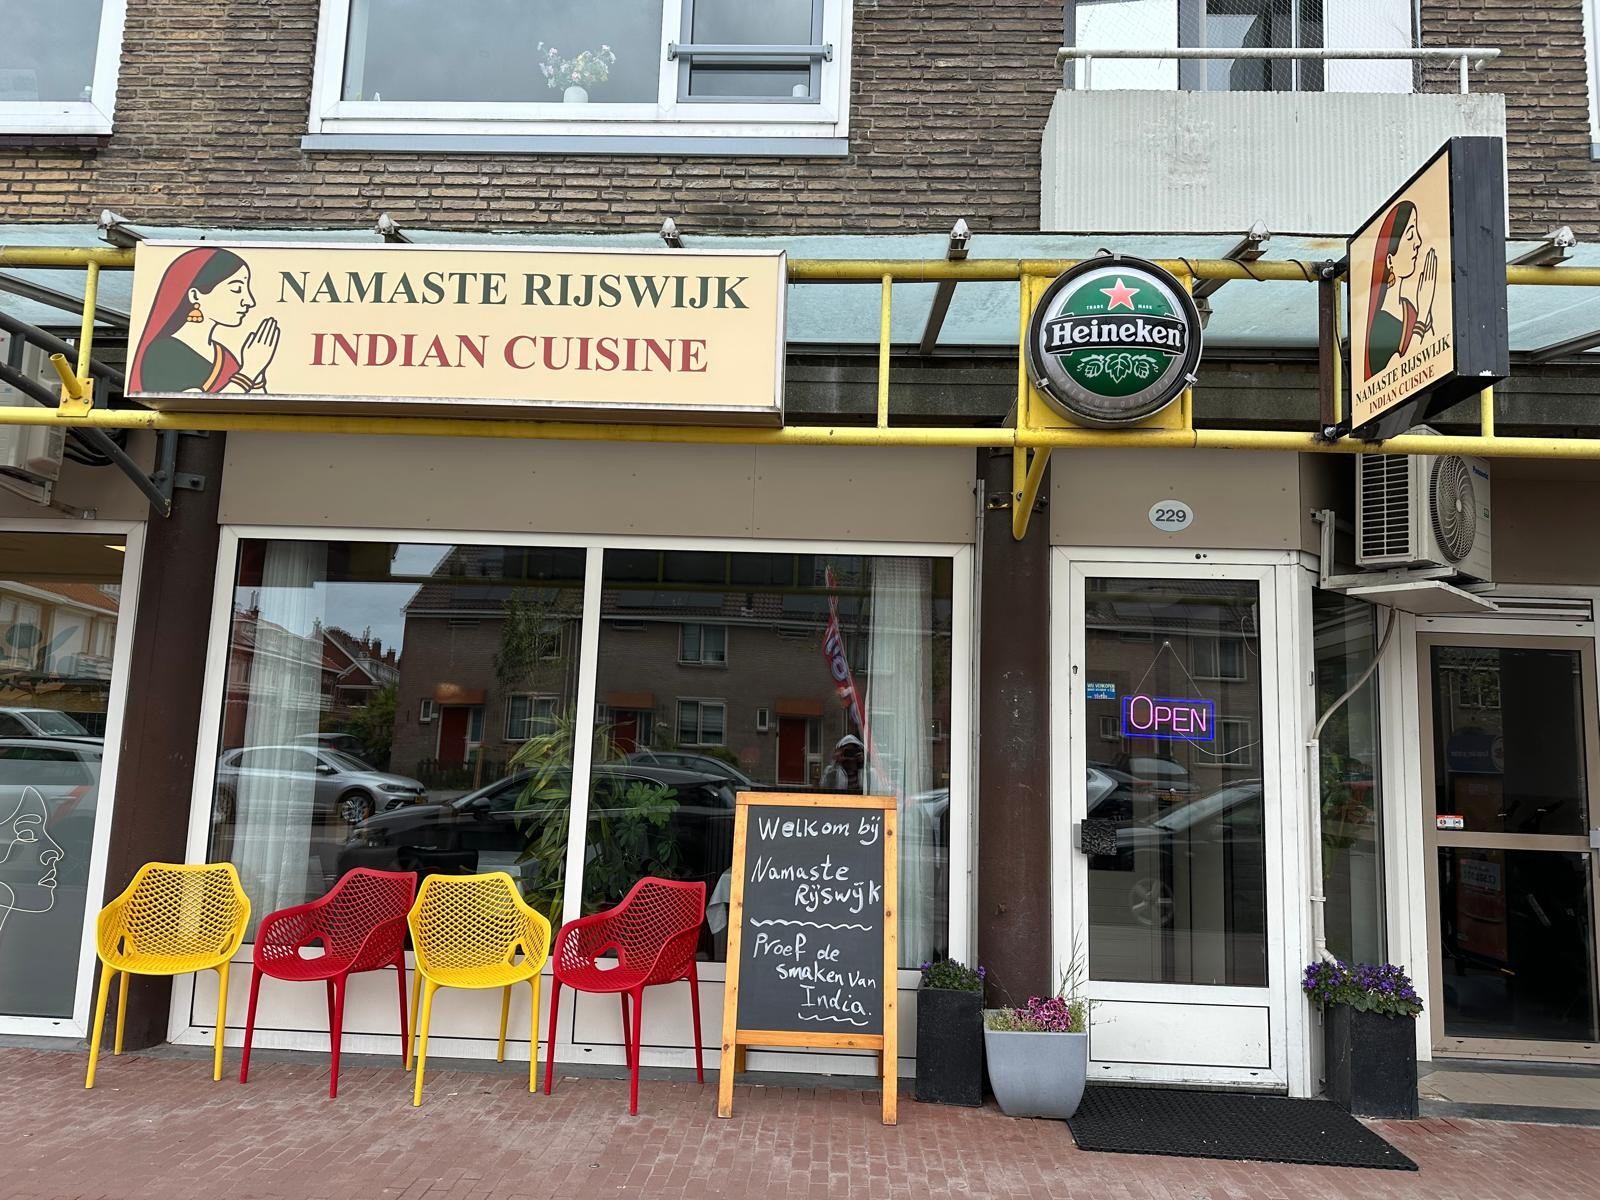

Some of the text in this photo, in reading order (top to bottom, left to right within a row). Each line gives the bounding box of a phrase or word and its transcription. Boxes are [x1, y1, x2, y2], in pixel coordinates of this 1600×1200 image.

[278, 270, 751, 310] NAMASTE RIJSWIJK
[1051, 319, 1181, 348] Heineken
[309, 331, 708, 373] INDIAN CUISINE
[1355, 333, 1451, 407] NAMASTE RIJSWIJK
[1369, 364, 1435, 414] INDIAN CUISINE
[1155, 508, 1187, 522] 229
[1129, 695, 1207, 733] OPEN
[758, 815, 881, 846] Welkom bij
[750, 853, 849, 883] Namaste
[816, 944, 841, 962] de
[775, 961, 844, 984] smaken
